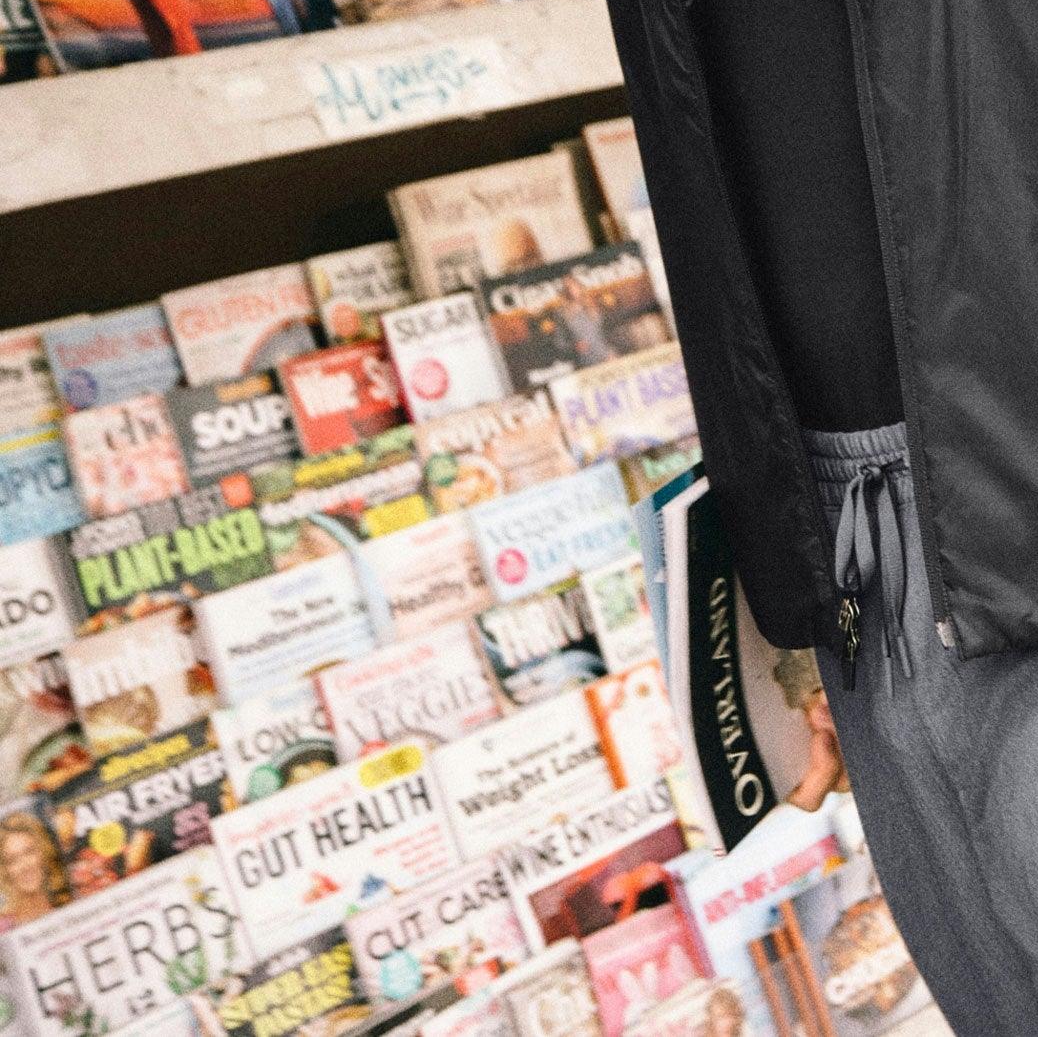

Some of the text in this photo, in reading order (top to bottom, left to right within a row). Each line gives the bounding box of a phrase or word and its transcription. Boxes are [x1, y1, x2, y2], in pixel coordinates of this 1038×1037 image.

[75, 507, 267, 608] PLANT-BASED
[707, 576, 765, 817] OVERLAND
[74, 784, 135, 839] AIR
[235, 830, 304, 891] GUT
[308, 776, 434, 859] HEALTH
[457, 766, 549, 819] Weight
[29, 886, 240, 1020] HERBS
